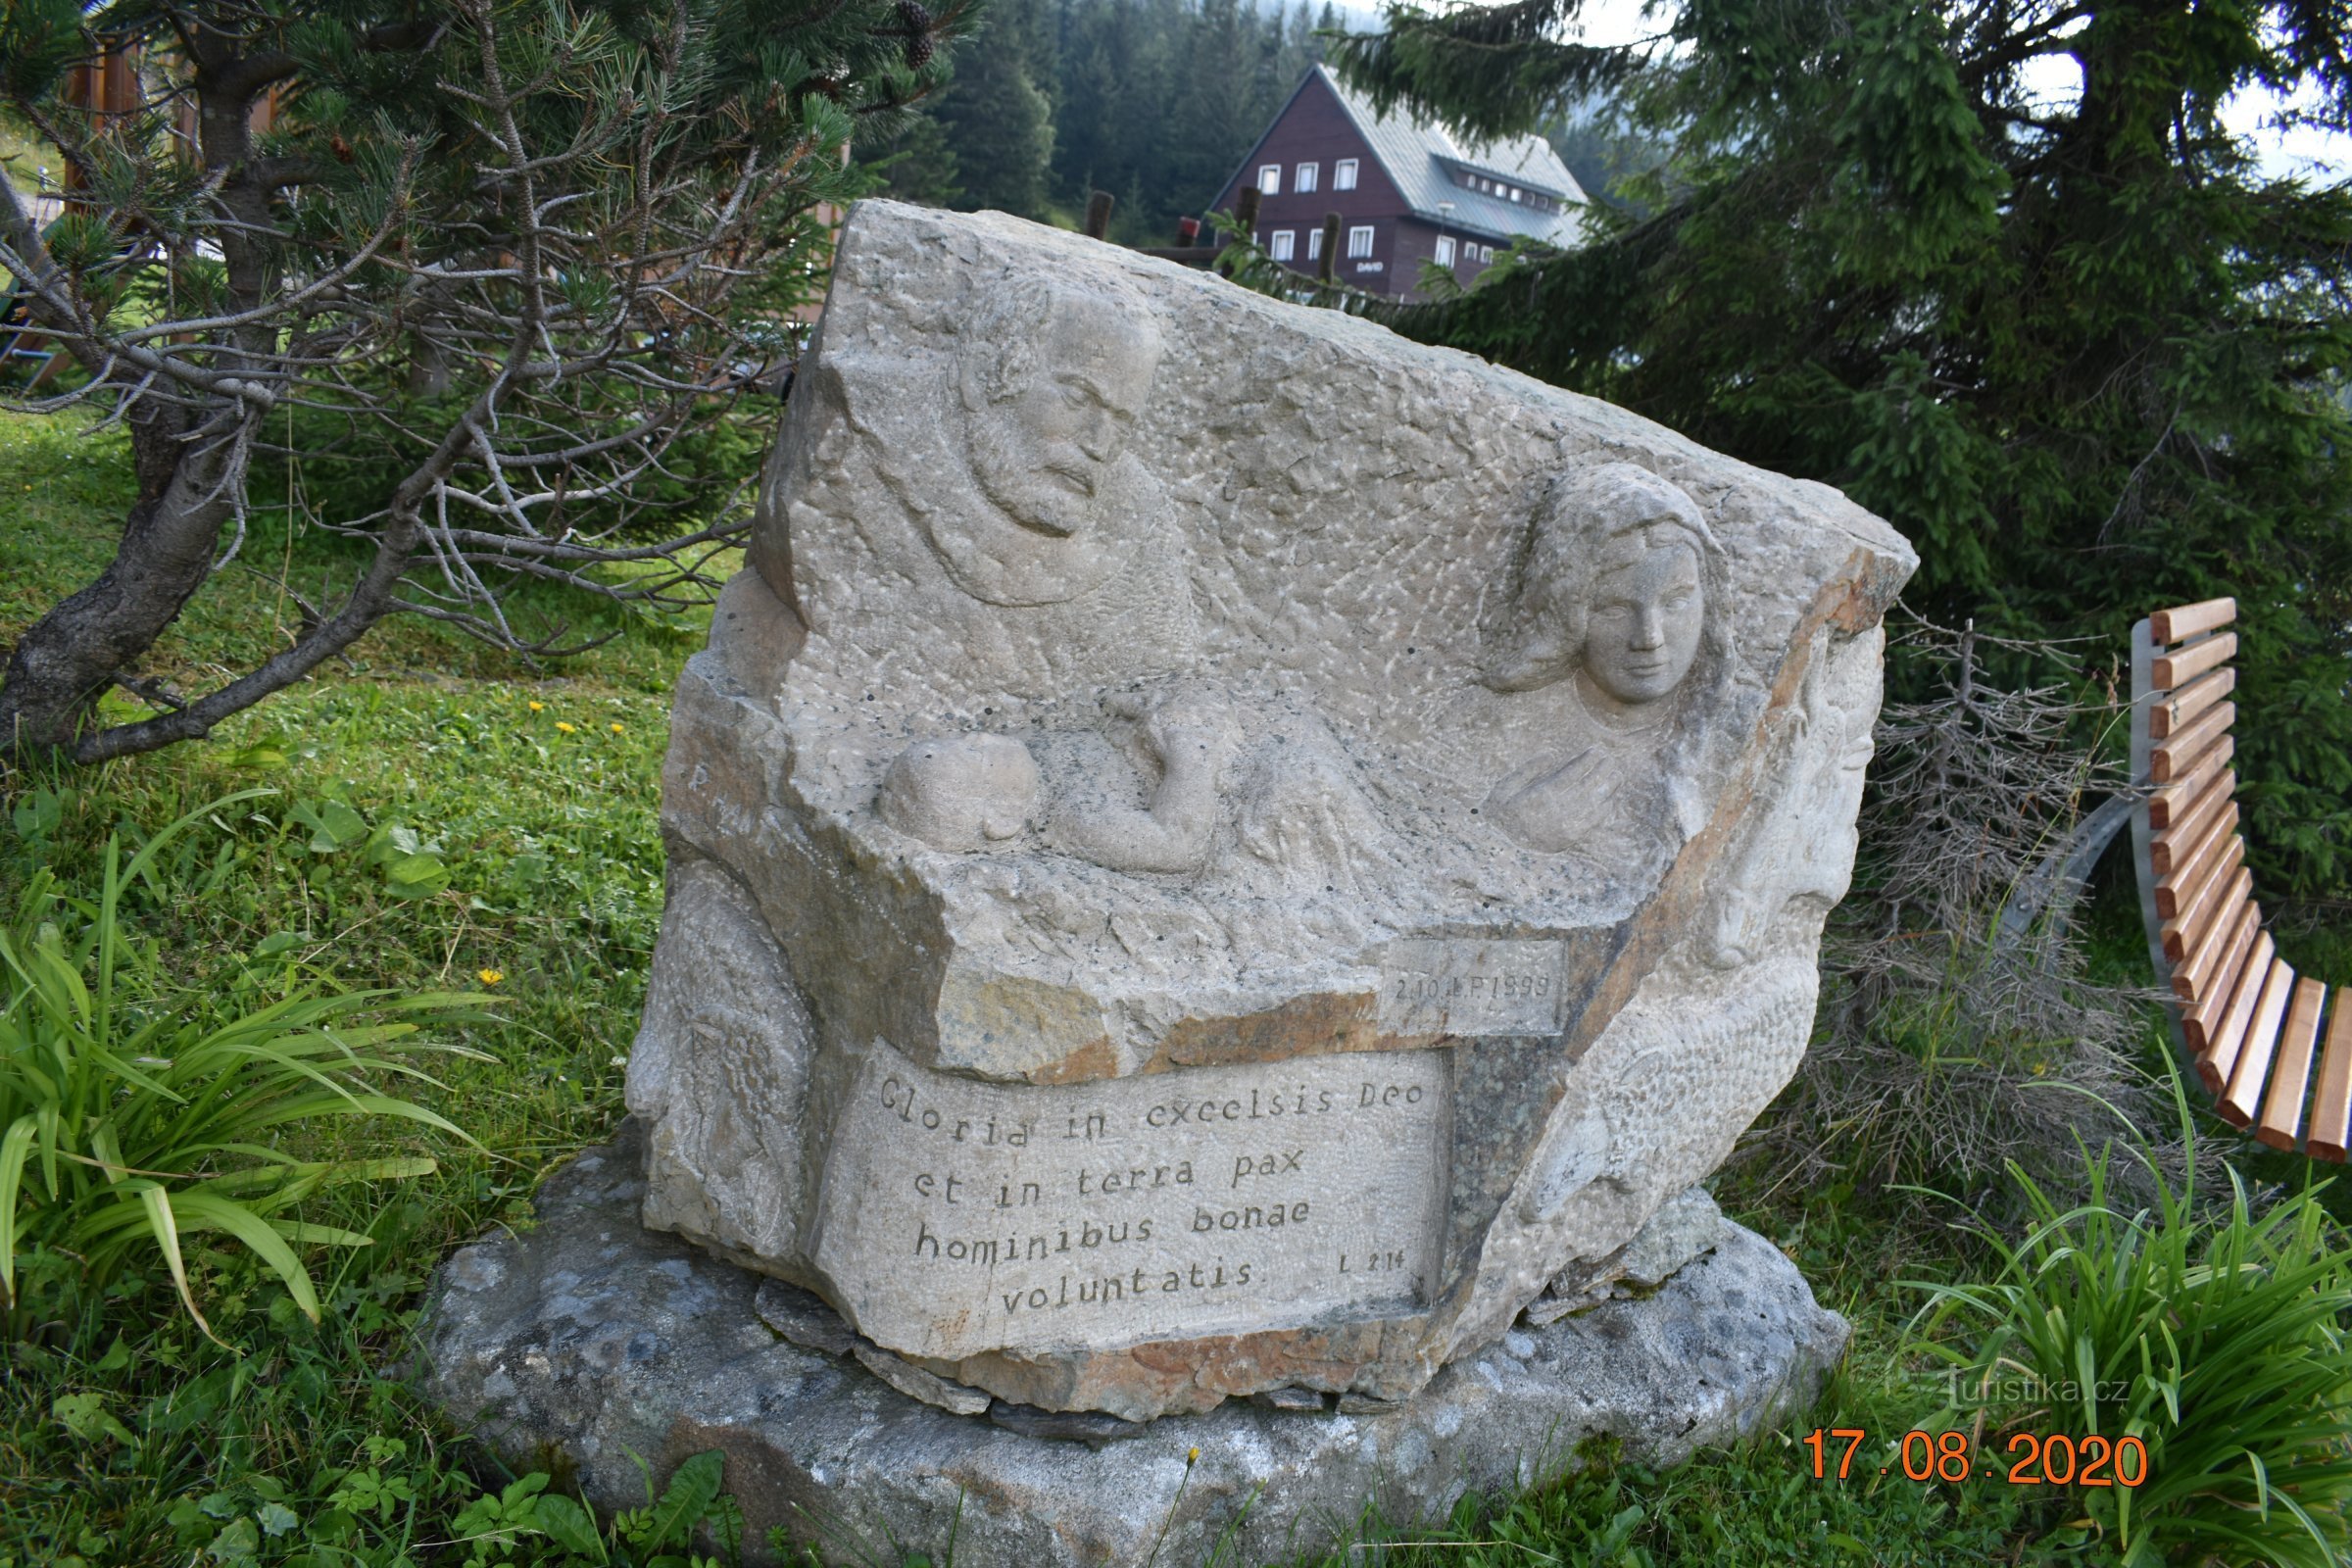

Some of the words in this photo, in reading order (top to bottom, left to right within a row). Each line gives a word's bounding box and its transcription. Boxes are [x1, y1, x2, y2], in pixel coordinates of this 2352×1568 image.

[881, 1078, 1029, 1148] Gloria
[1062, 1104, 1106, 1141] in
[1146, 1084, 1333, 1128] excelsis
[1358, 1081, 1422, 1109] Deo
[914, 1173, 963, 1204] et
[995, 1174, 1041, 1208] in
[1078, 1159, 1195, 1195] terra
[1230, 1149, 1304, 1190] pax
[912, 1218, 1153, 1265] hominibus
[1191, 1201, 1310, 1233] bonae
